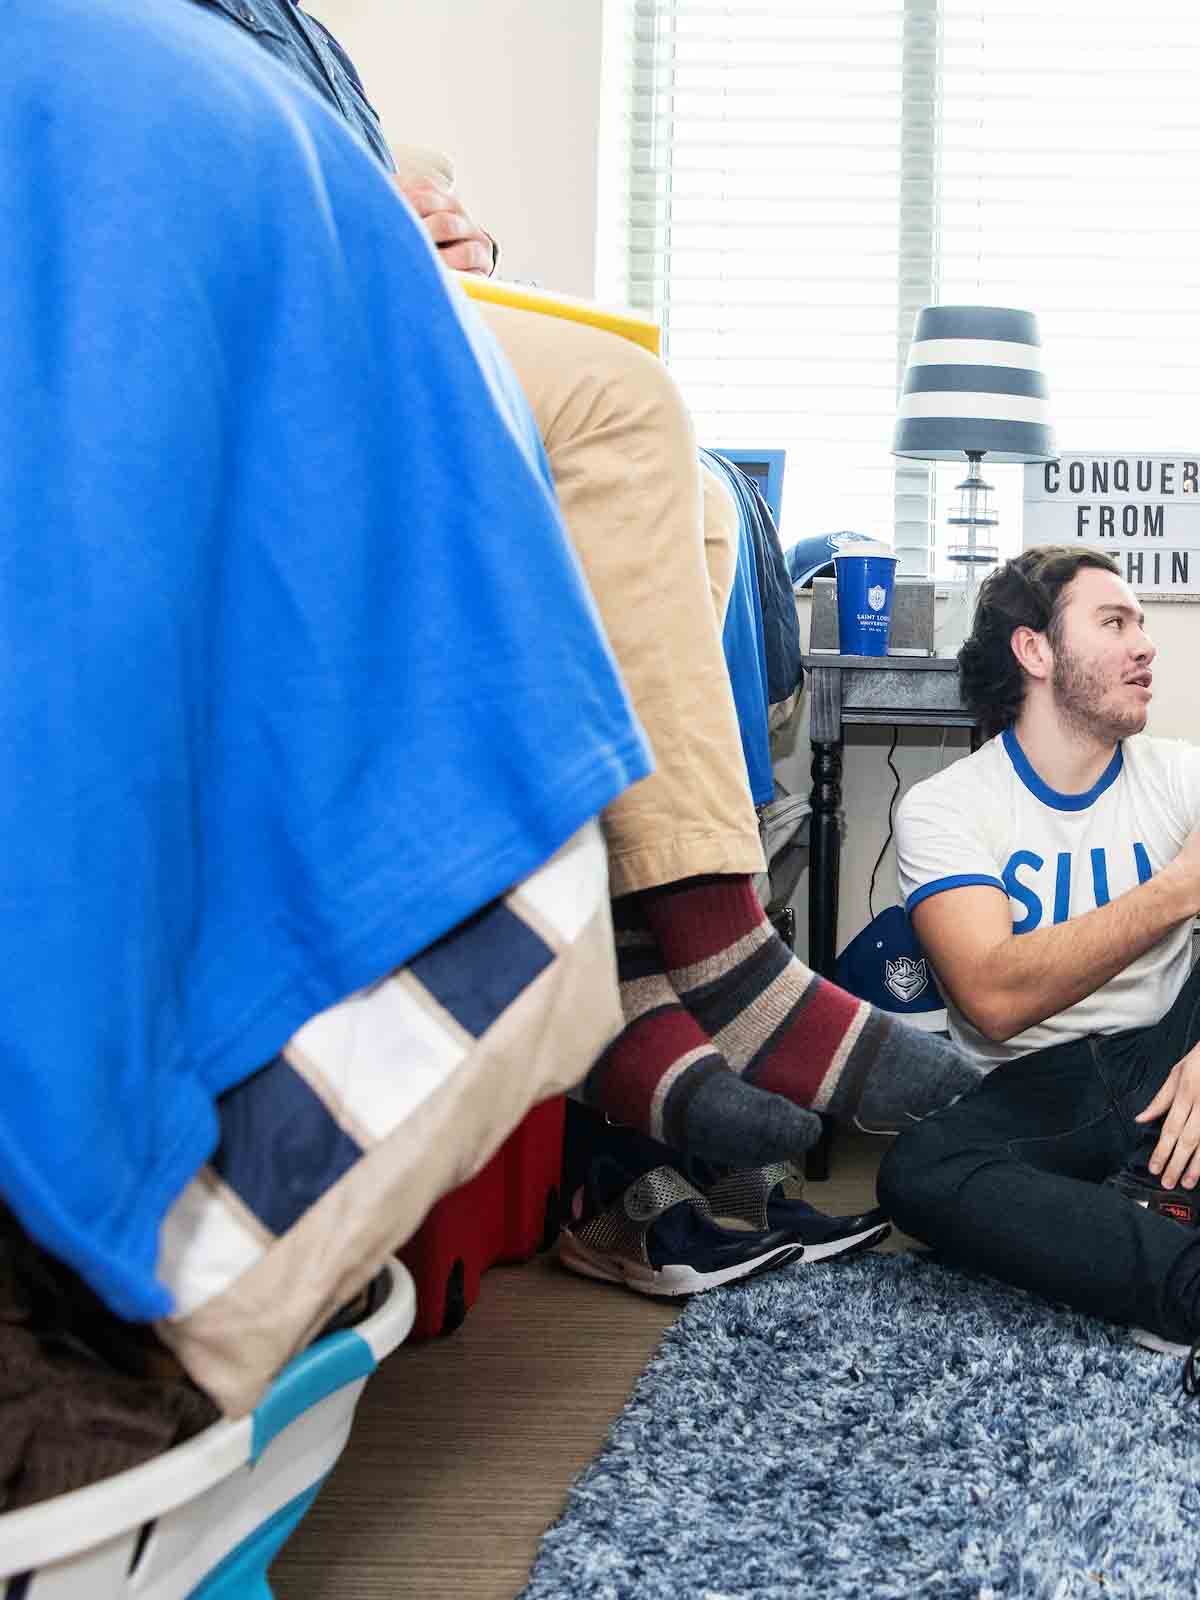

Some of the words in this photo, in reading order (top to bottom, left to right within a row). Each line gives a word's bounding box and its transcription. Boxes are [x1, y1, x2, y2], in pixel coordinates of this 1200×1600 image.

[1044, 459, 1200, 495] CONQUER
[1077, 504, 1164, 537] FROM
[856, 613, 876, 621] SAINT
